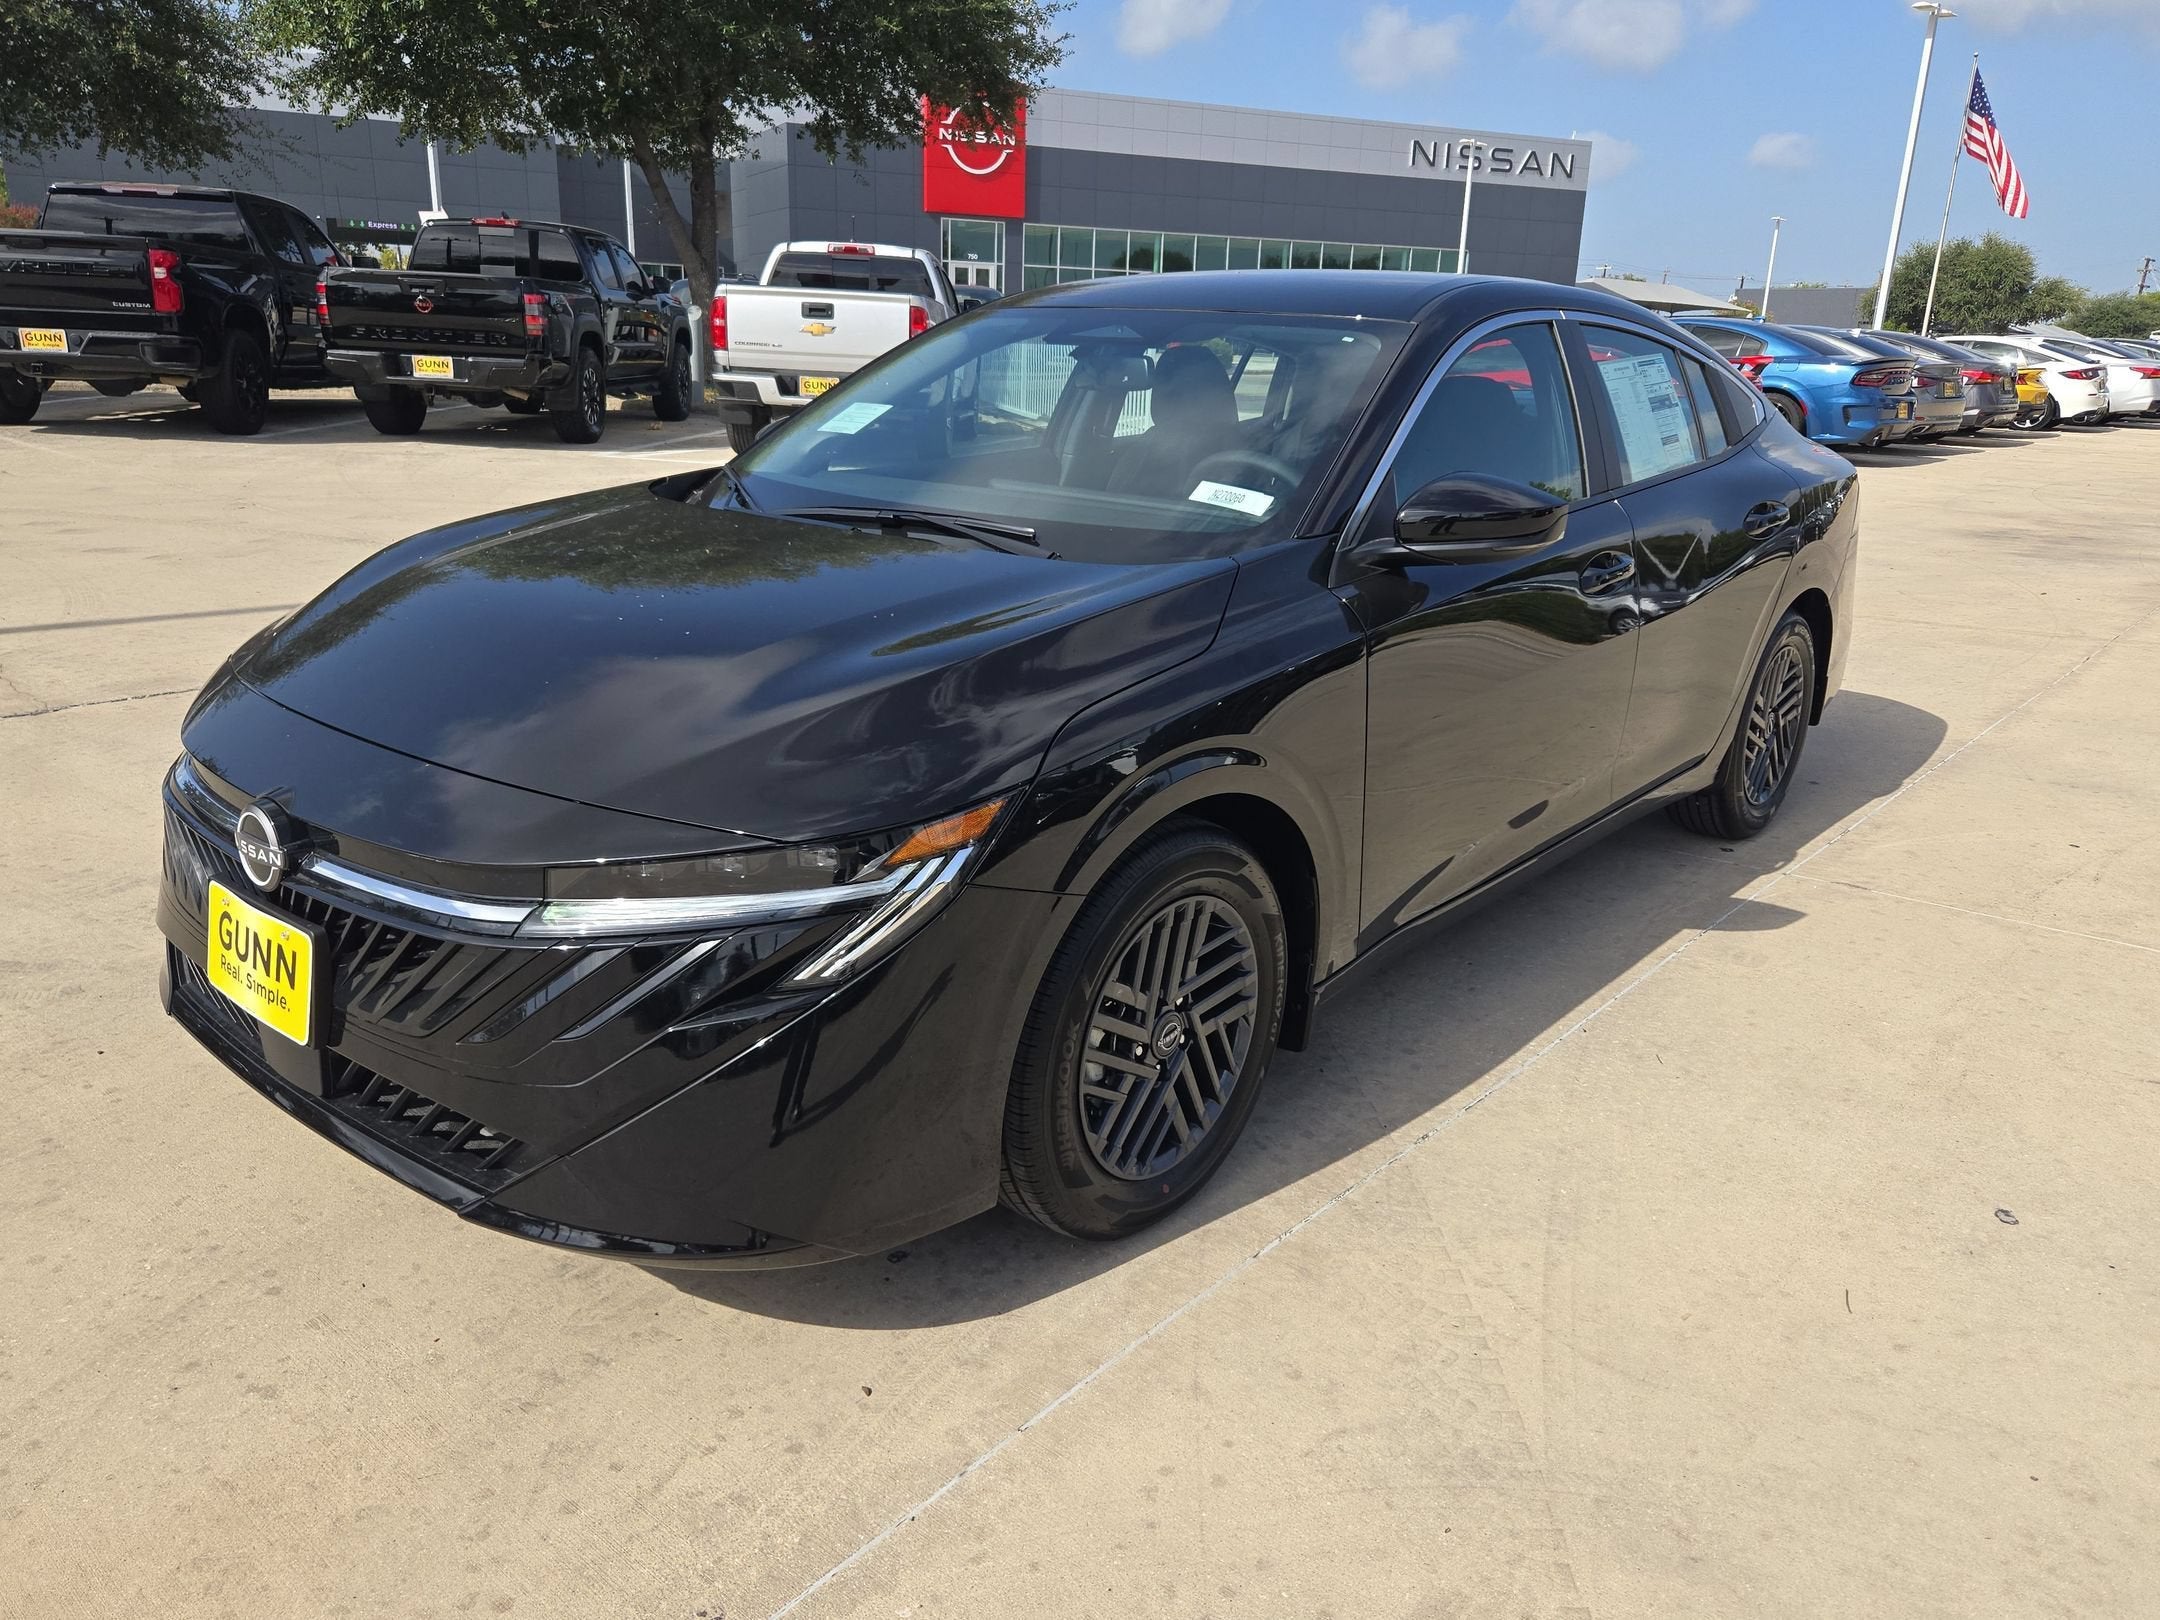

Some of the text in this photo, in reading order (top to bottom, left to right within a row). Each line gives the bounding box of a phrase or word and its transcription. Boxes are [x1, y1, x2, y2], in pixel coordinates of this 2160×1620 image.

[1409, 139, 1575, 179] NISSAN
[367, 220, 398, 230] Express
[24, 332, 63, 343] GUNN
[416, 359, 449, 369] GUNN
[219, 910, 297, 990] GUNN
[220, 953, 290, 1013] Real. Simple.
